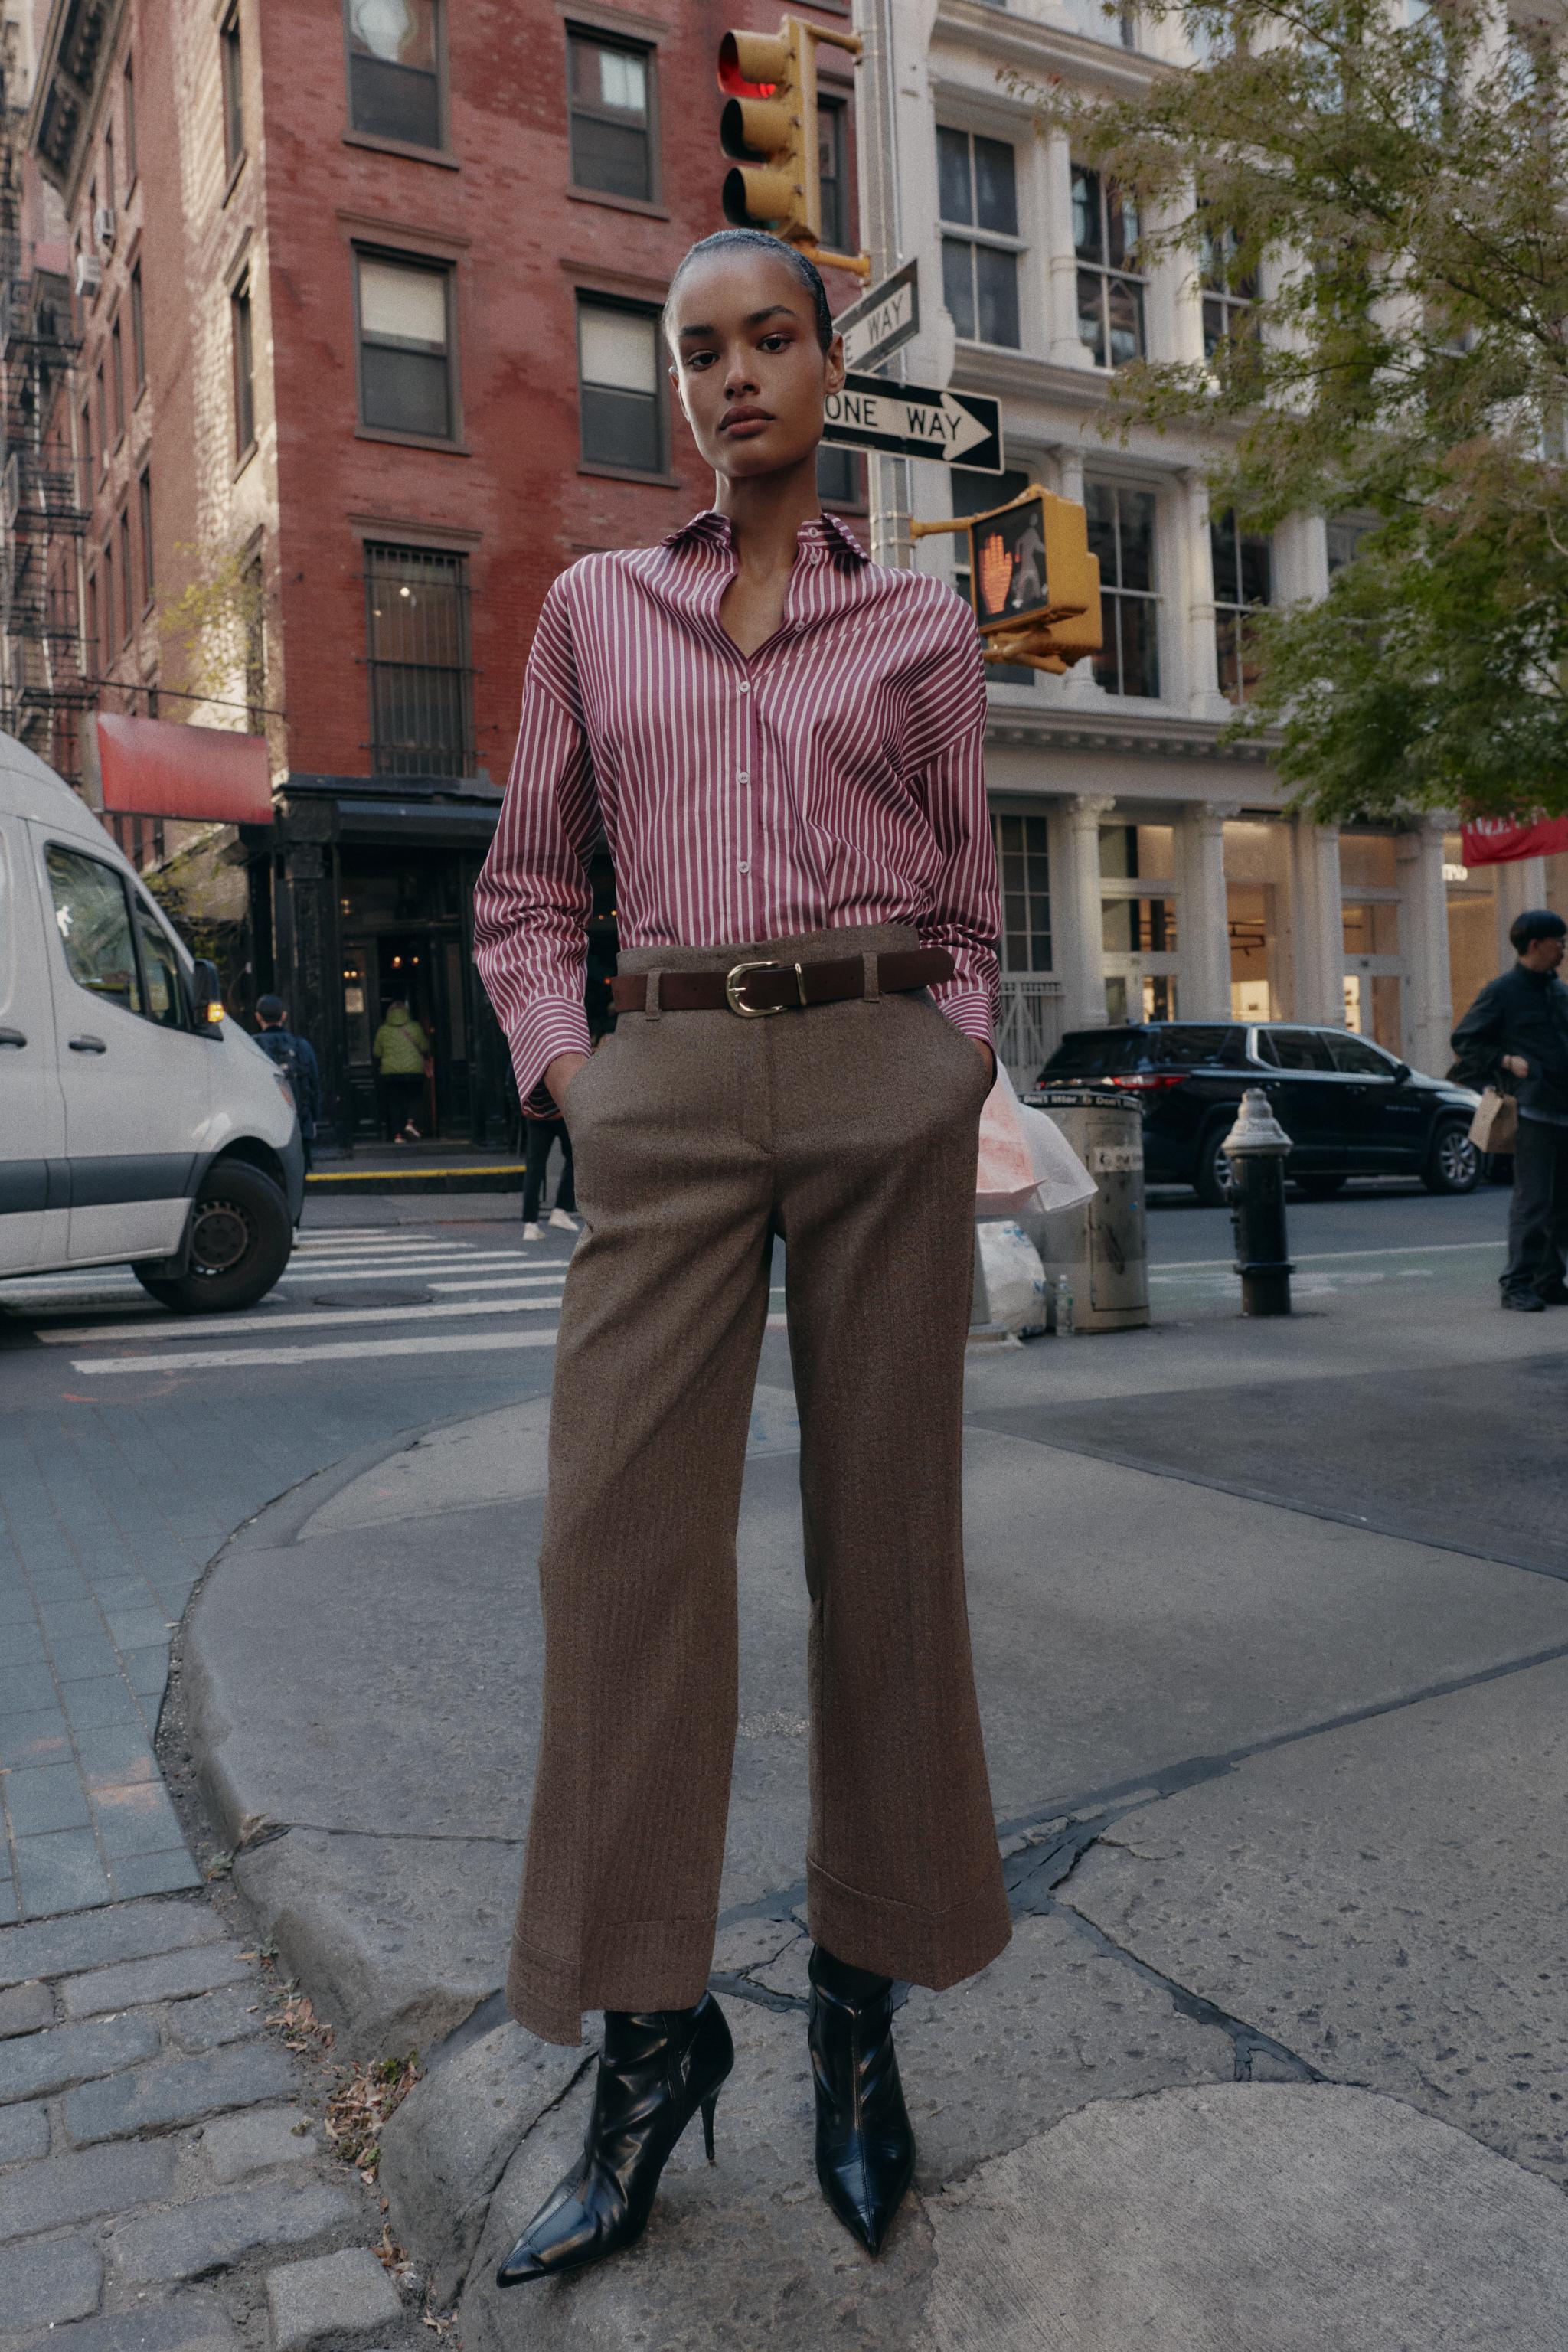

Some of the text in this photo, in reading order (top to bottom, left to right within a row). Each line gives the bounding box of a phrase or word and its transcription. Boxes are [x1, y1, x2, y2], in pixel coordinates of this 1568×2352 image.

[867, 293, 904, 345] WAY
[825, 394, 962, 441] ONE WAY
